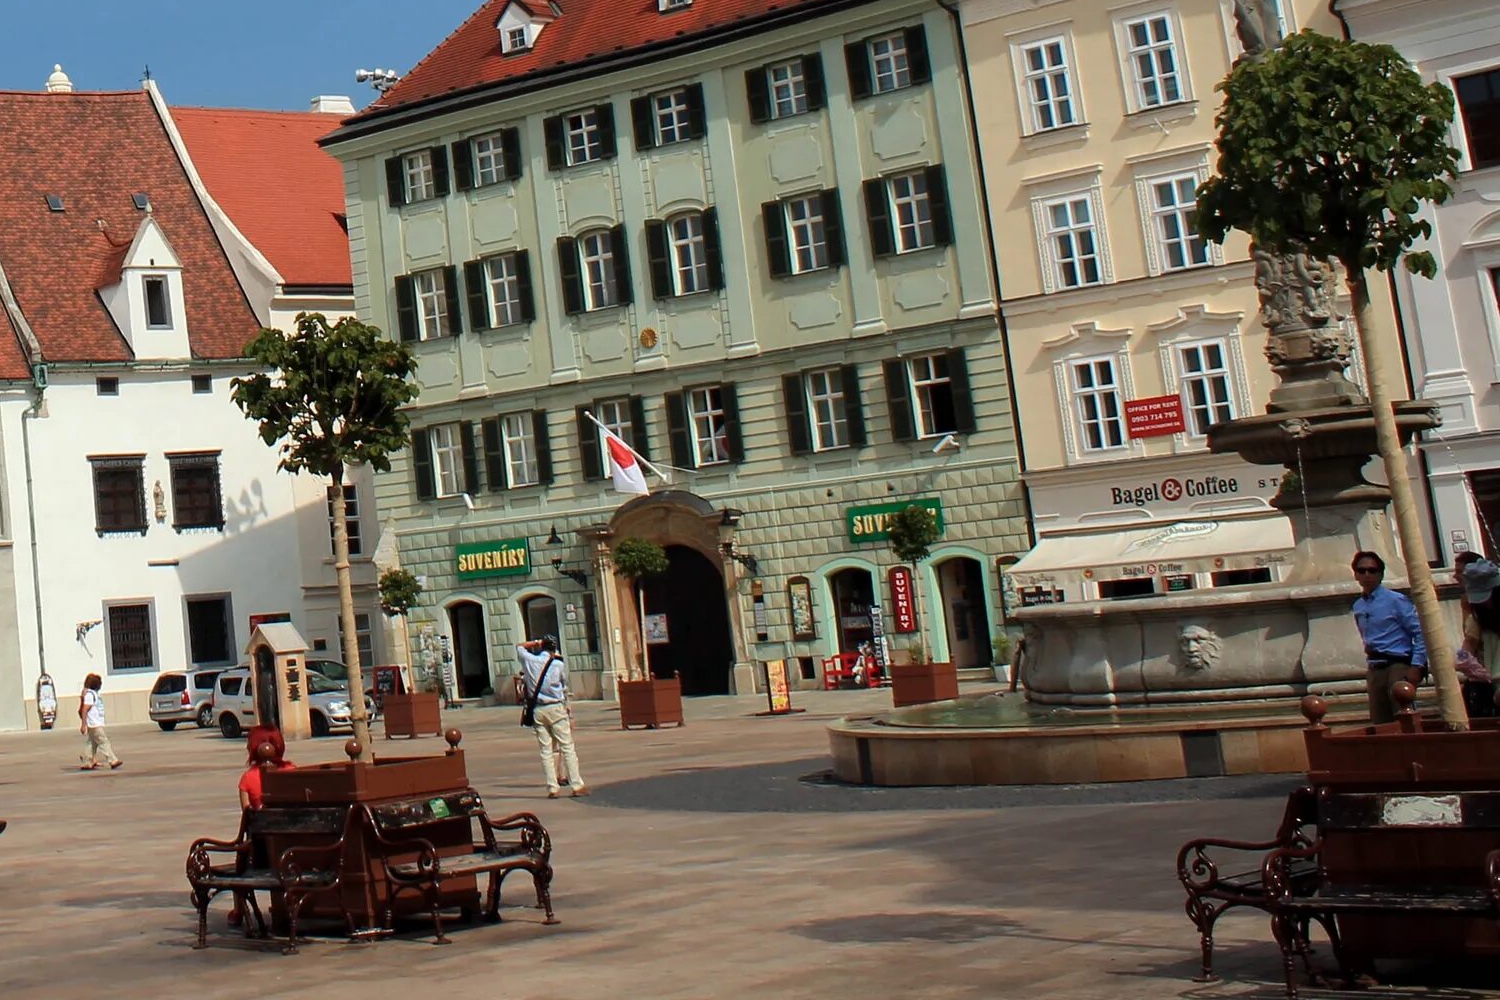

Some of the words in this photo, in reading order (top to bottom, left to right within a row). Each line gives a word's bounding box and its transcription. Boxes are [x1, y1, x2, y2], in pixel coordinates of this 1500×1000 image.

[1127, 405, 1149, 414] OFFICE
[1149, 403, 1161, 411] FOR
[1162, 400, 1178, 409] RENT
[1111, 483, 1159, 507] Bagel
[1163, 480, 1181, 498] &
[1185, 475, 1238, 498] Coffee
[458, 544, 526, 572] SUVENÍRY
[1122, 565, 1145, 576] Bagel
[1158, 564, 1183, 573] Coffee
[895, 572, 910, 629] SUVENIRY
